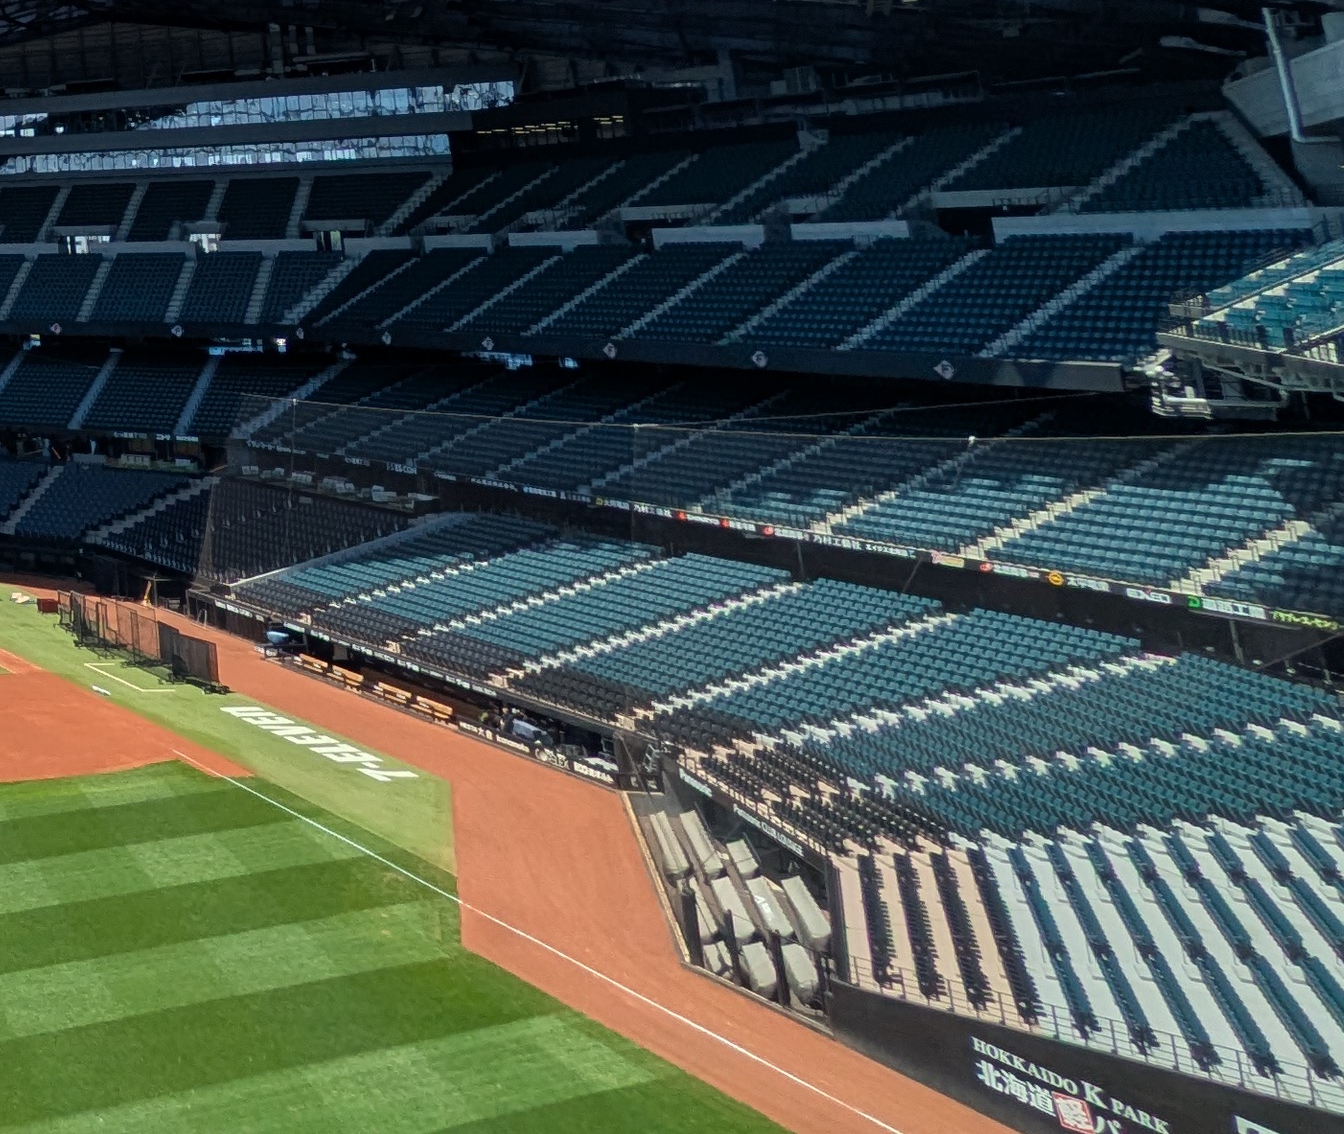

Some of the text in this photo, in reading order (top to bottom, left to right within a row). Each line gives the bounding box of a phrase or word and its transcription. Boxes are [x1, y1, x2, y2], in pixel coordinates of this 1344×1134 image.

[971, 1036, 1170, 1134] HOKKAIDO K PARK
